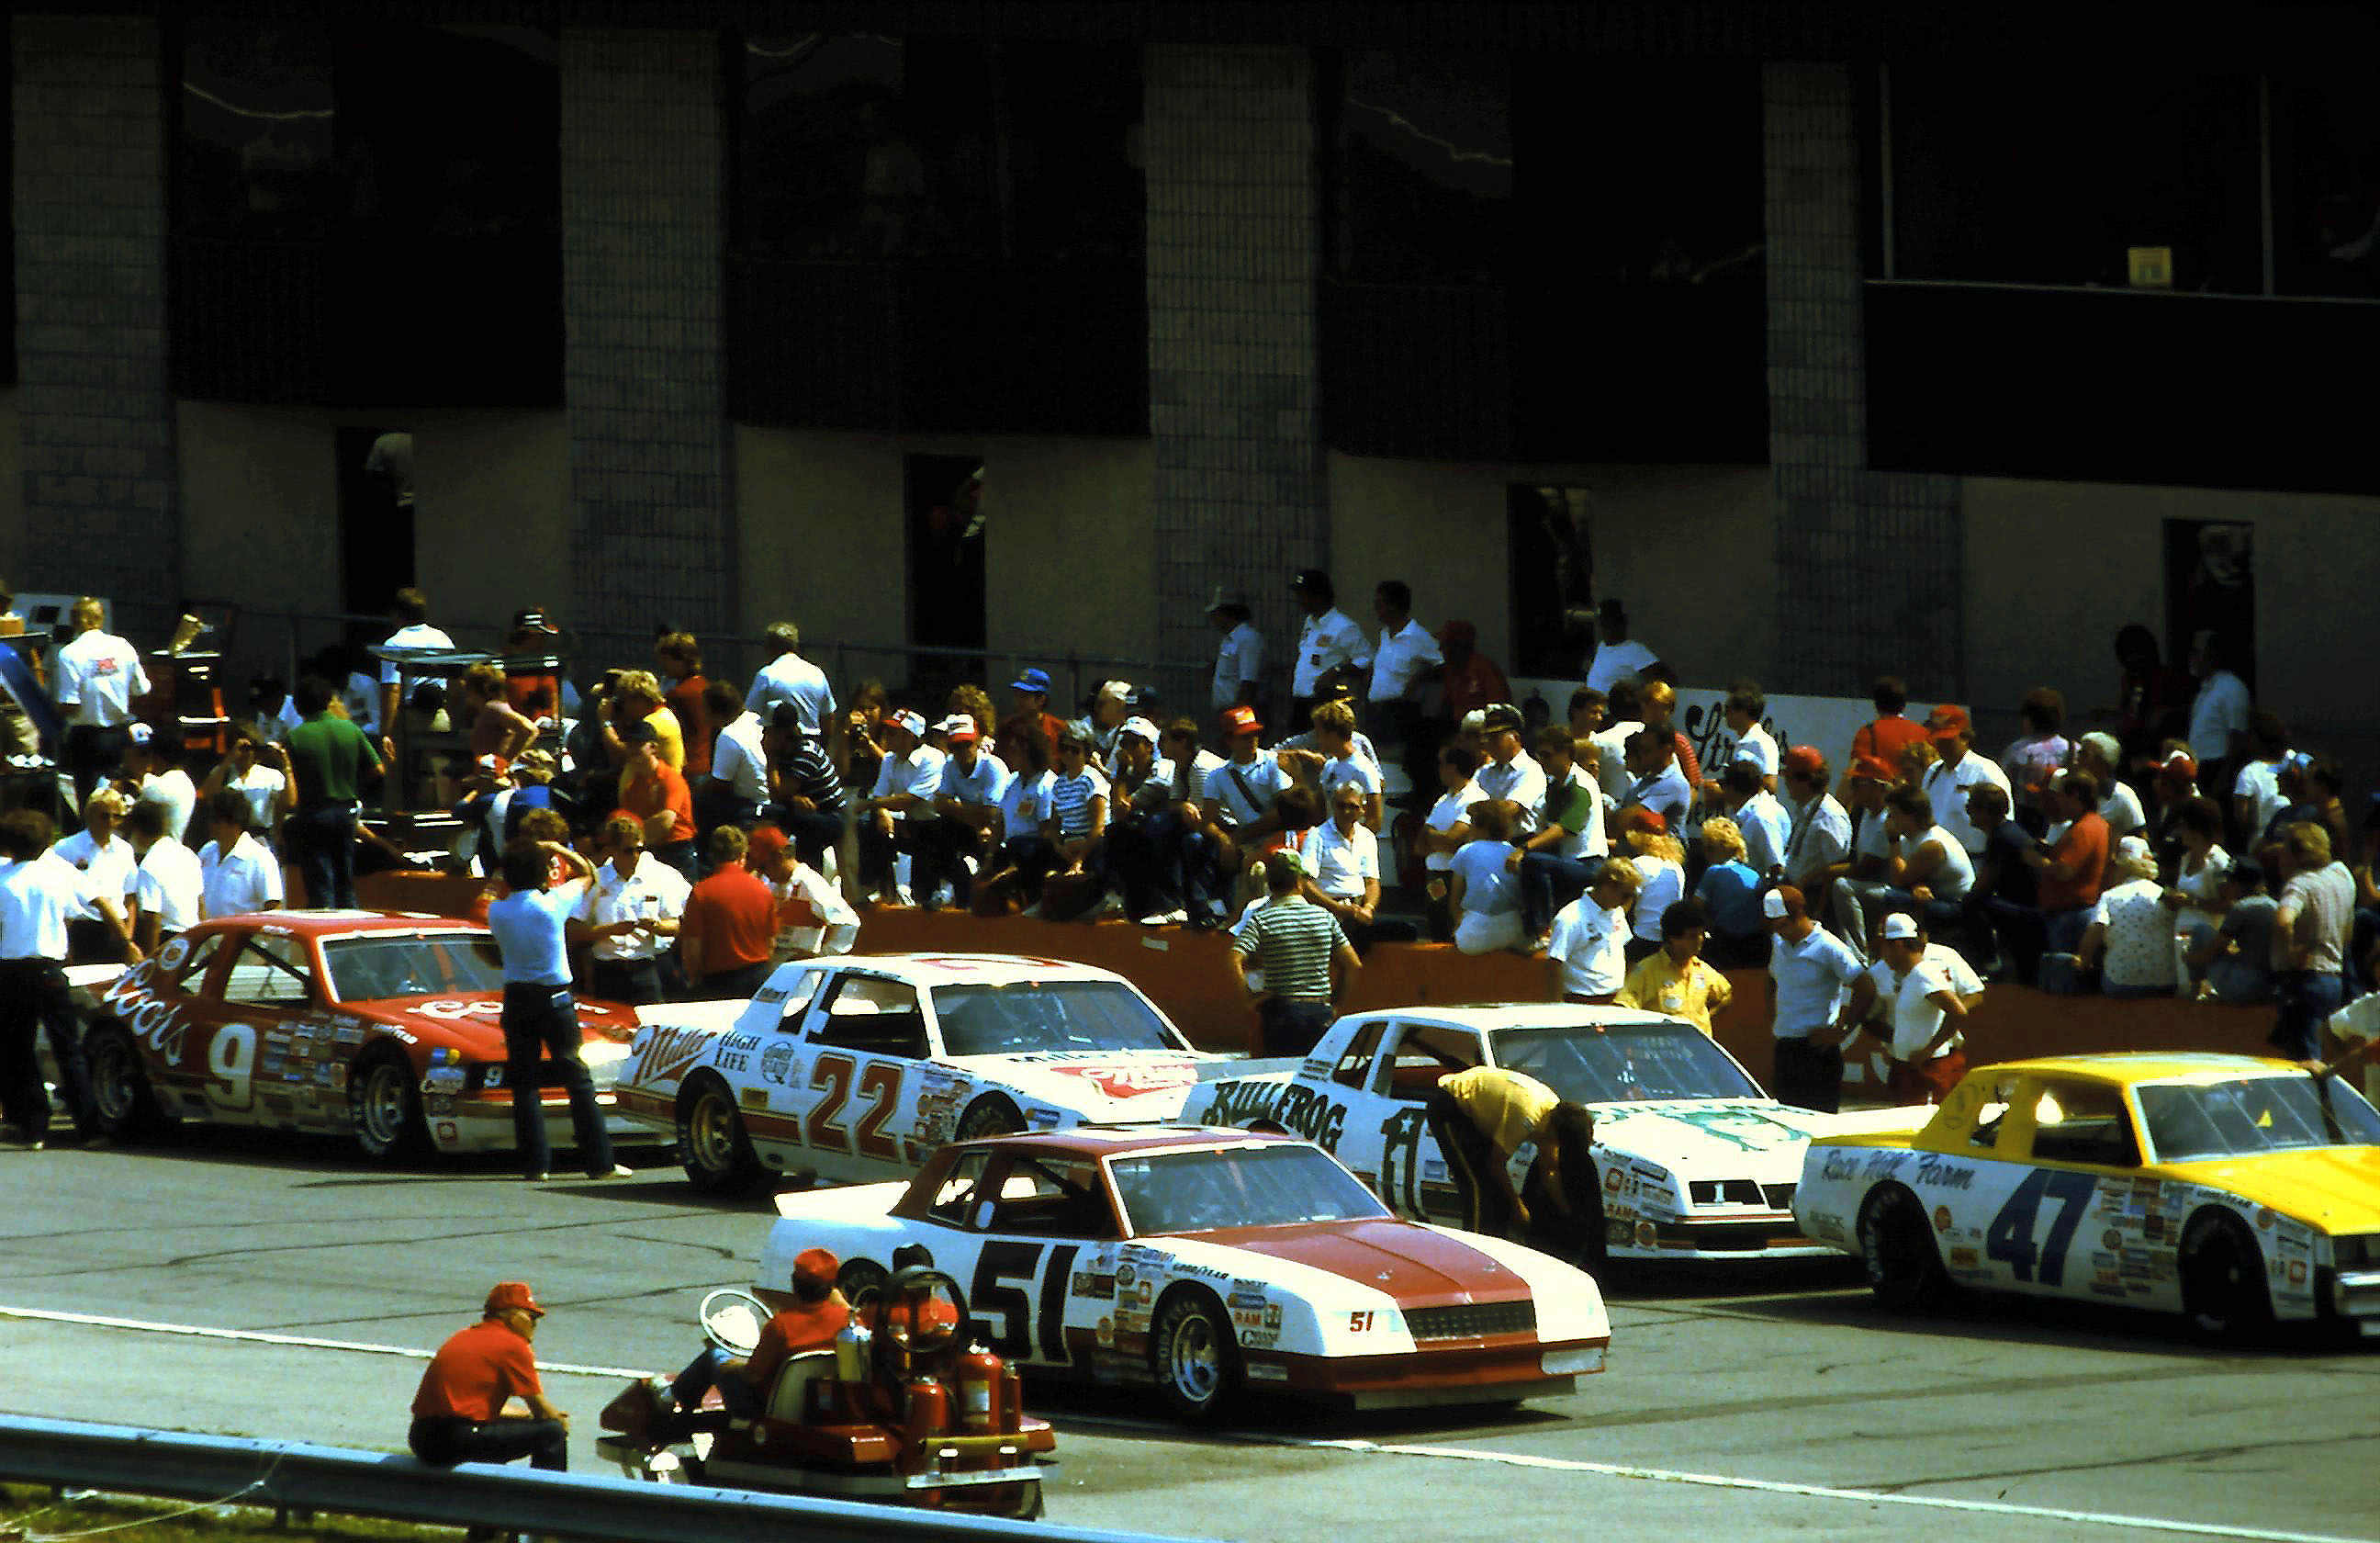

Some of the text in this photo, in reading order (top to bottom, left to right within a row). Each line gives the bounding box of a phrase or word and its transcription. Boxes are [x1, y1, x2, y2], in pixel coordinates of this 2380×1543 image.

[103, 958, 191, 1067] Coors
[206, 1022, 256, 1111] 9
[484, 1064, 504, 1087] 9
[632, 1024, 718, 1087] Miller
[807, 1051, 904, 1164] 22
[1201, 1080, 1348, 1156] BULLFROG
[1916, 1153, 1976, 1191] Farm
[1987, 1167, 2100, 1287] 47
[970, 1240, 1081, 1363] 51
[1350, 1311, 1375, 1333] 51
